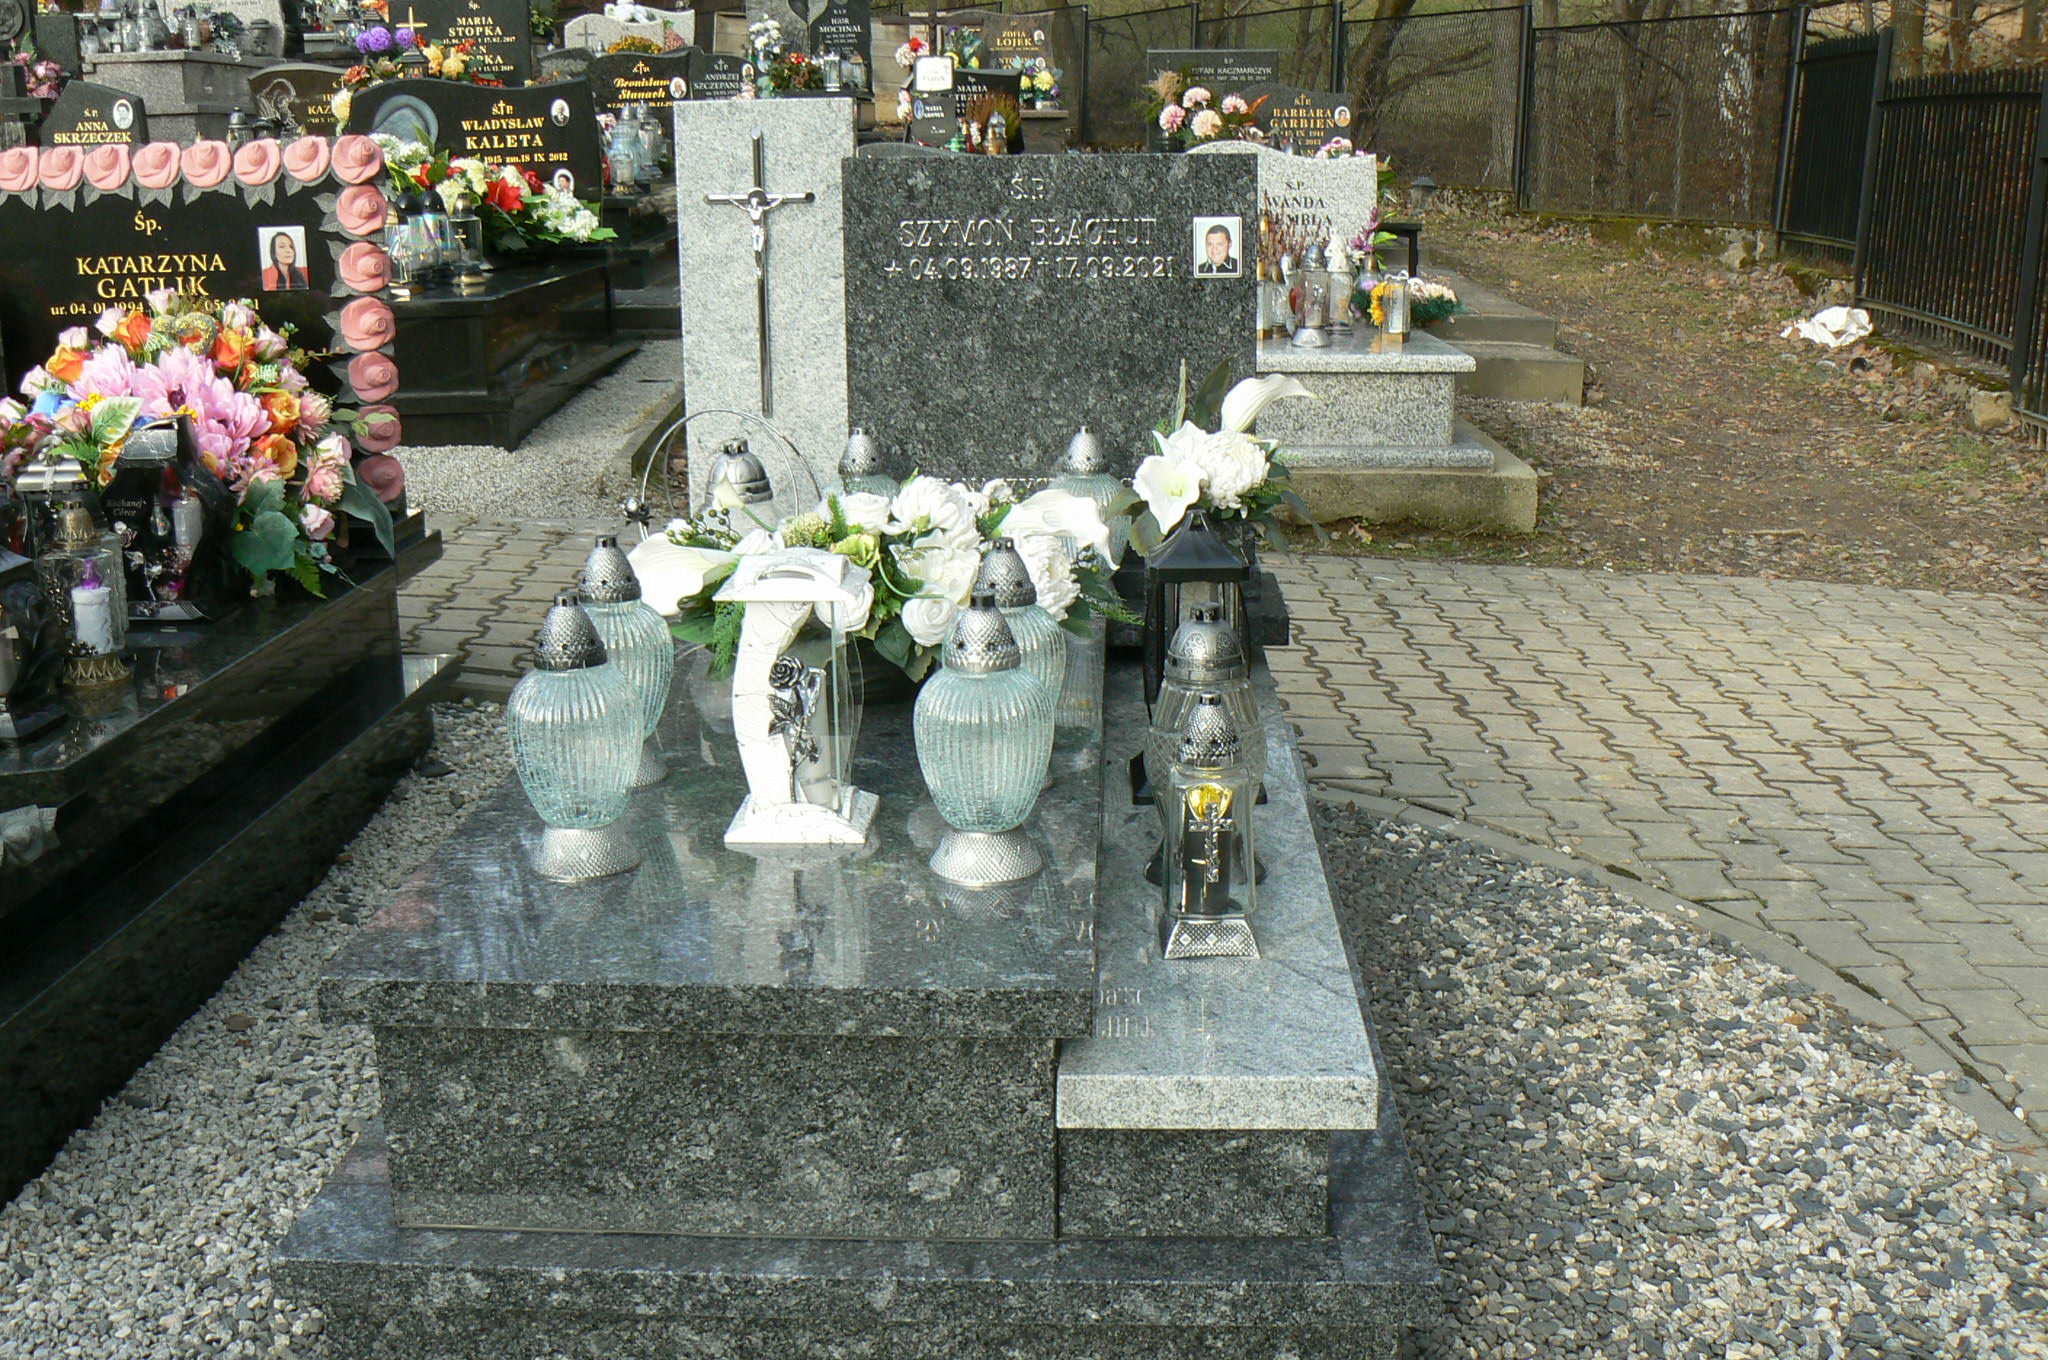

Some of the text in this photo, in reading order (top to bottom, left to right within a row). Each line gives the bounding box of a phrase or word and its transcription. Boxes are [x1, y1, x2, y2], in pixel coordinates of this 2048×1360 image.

[456, 16, 494, 26] MARIA
[448, 26, 503, 37] STOPKA
[705, 73, 739, 81] ANDRZEJ
[1273, 108, 1333, 118] BARBARA
[76, 121, 109, 131] ANNA
[461, 117, 545, 131] WŁADYSŁAW
[54, 132, 132, 144] SKRZECZEK
[465, 134, 544, 150] KALETA
[534, 152, 545, 162] IX
[549, 152, 568, 162] 2012
[1264, 196, 1325, 209] WANDA
[134, 210, 162, 235] Śp.
[900, 218, 1157, 248] SZYMON BŁACHUT
[76, 253, 227, 276] KATARZYNA
[909, 255, 1174, 281] 04.09.1987 17.09.2021
[69, 301, 146, 316] 04.011994
